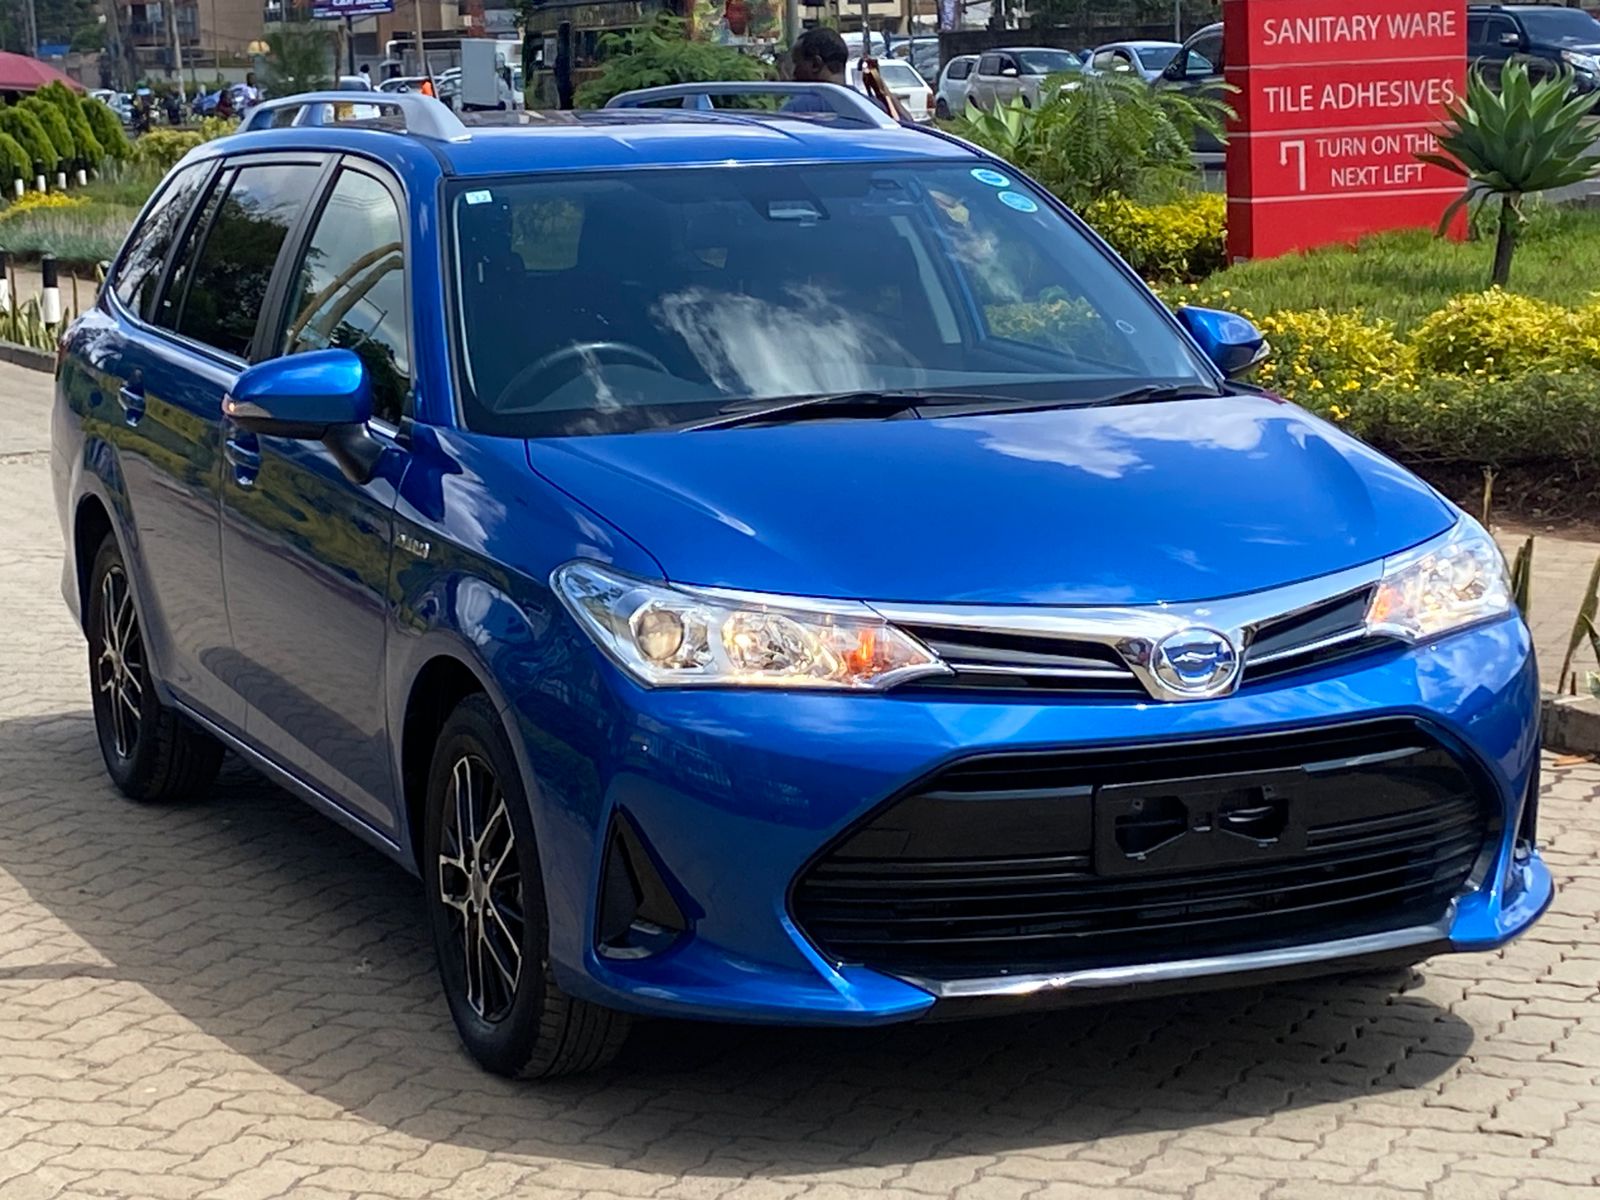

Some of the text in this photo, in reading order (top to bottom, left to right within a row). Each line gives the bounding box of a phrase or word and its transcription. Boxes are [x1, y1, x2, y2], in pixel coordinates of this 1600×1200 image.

[1263, 10, 1457, 46] SANITARY WARE
[1263, 78, 1455, 113] TILE ADHESIVES
[1315, 133, 1440, 158] TURN ON THE
[1331, 163, 1427, 188] NEXT LEFT
